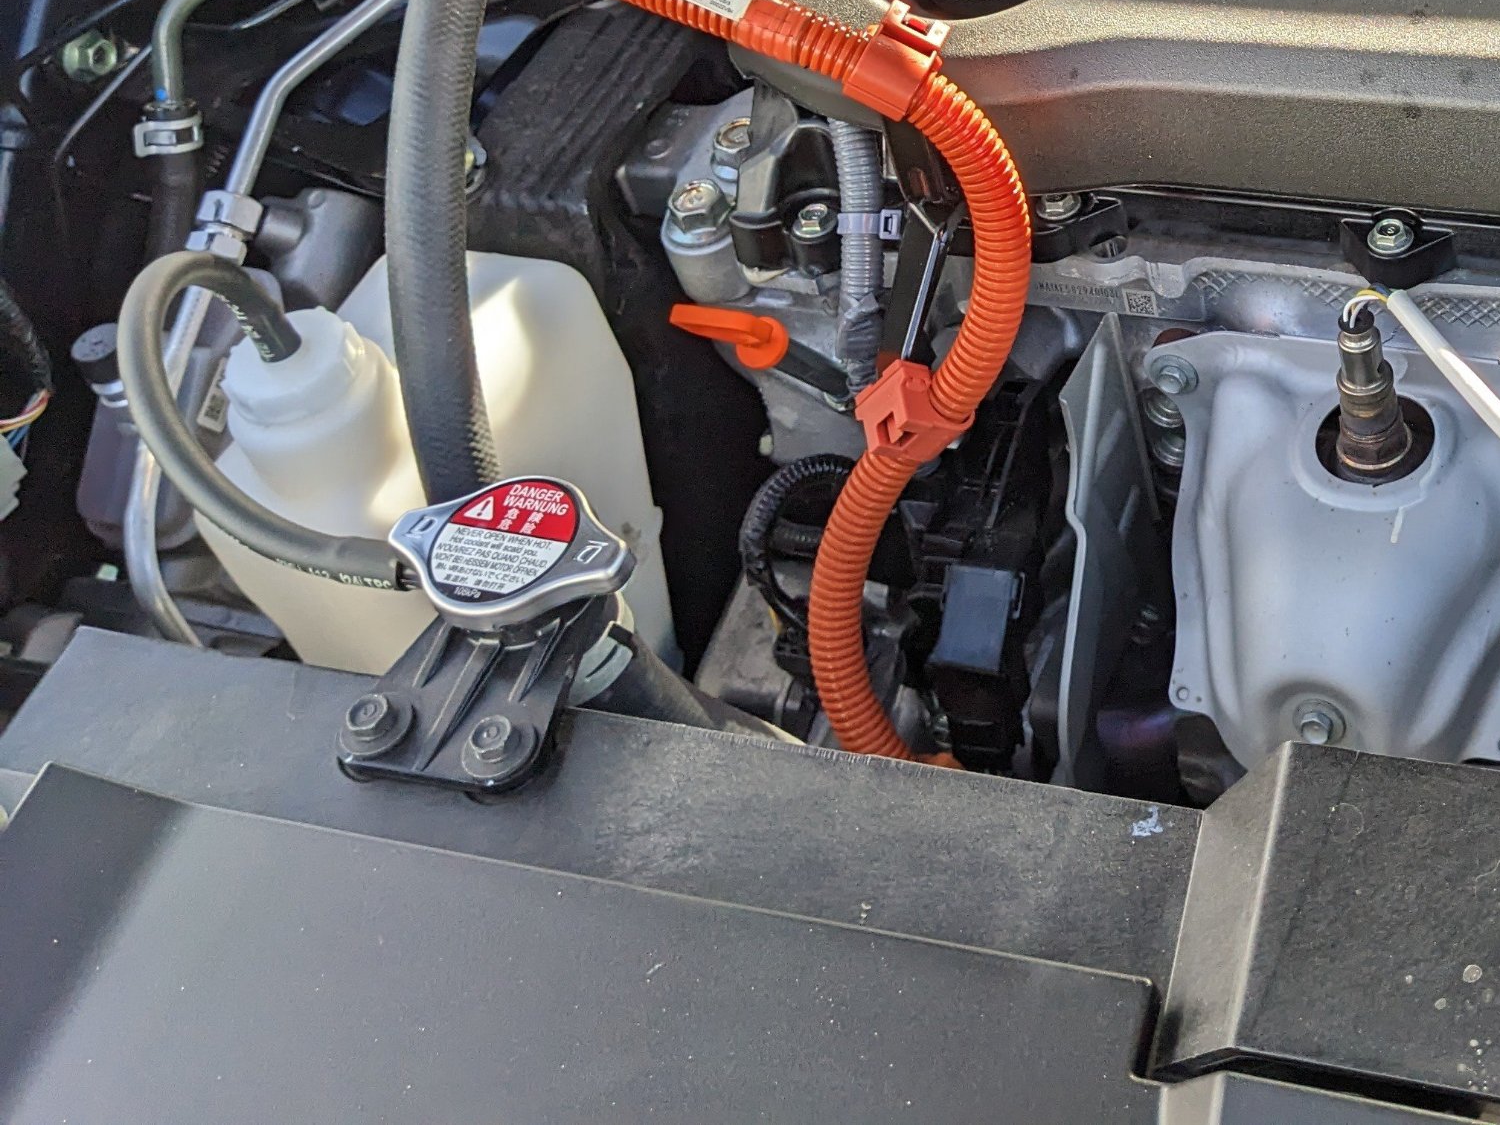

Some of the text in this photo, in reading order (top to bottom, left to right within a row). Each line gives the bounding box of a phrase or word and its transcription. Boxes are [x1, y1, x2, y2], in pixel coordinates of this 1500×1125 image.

[509, 484, 565, 502] DANGER
[503, 495, 569, 515] WARNUNG
[449, 535, 464, 543] Hot
[464, 539, 490, 547] coolant
[490, 542, 504, 550] will
[503, 545, 523, 554] scald
[455, 527, 552, 551] NEVER OPEN WHEN HOT.
[475, 549, 491, 558] PAS
[491, 551, 519, 563] QUAND
[490, 561, 514, 571] MOTOR
